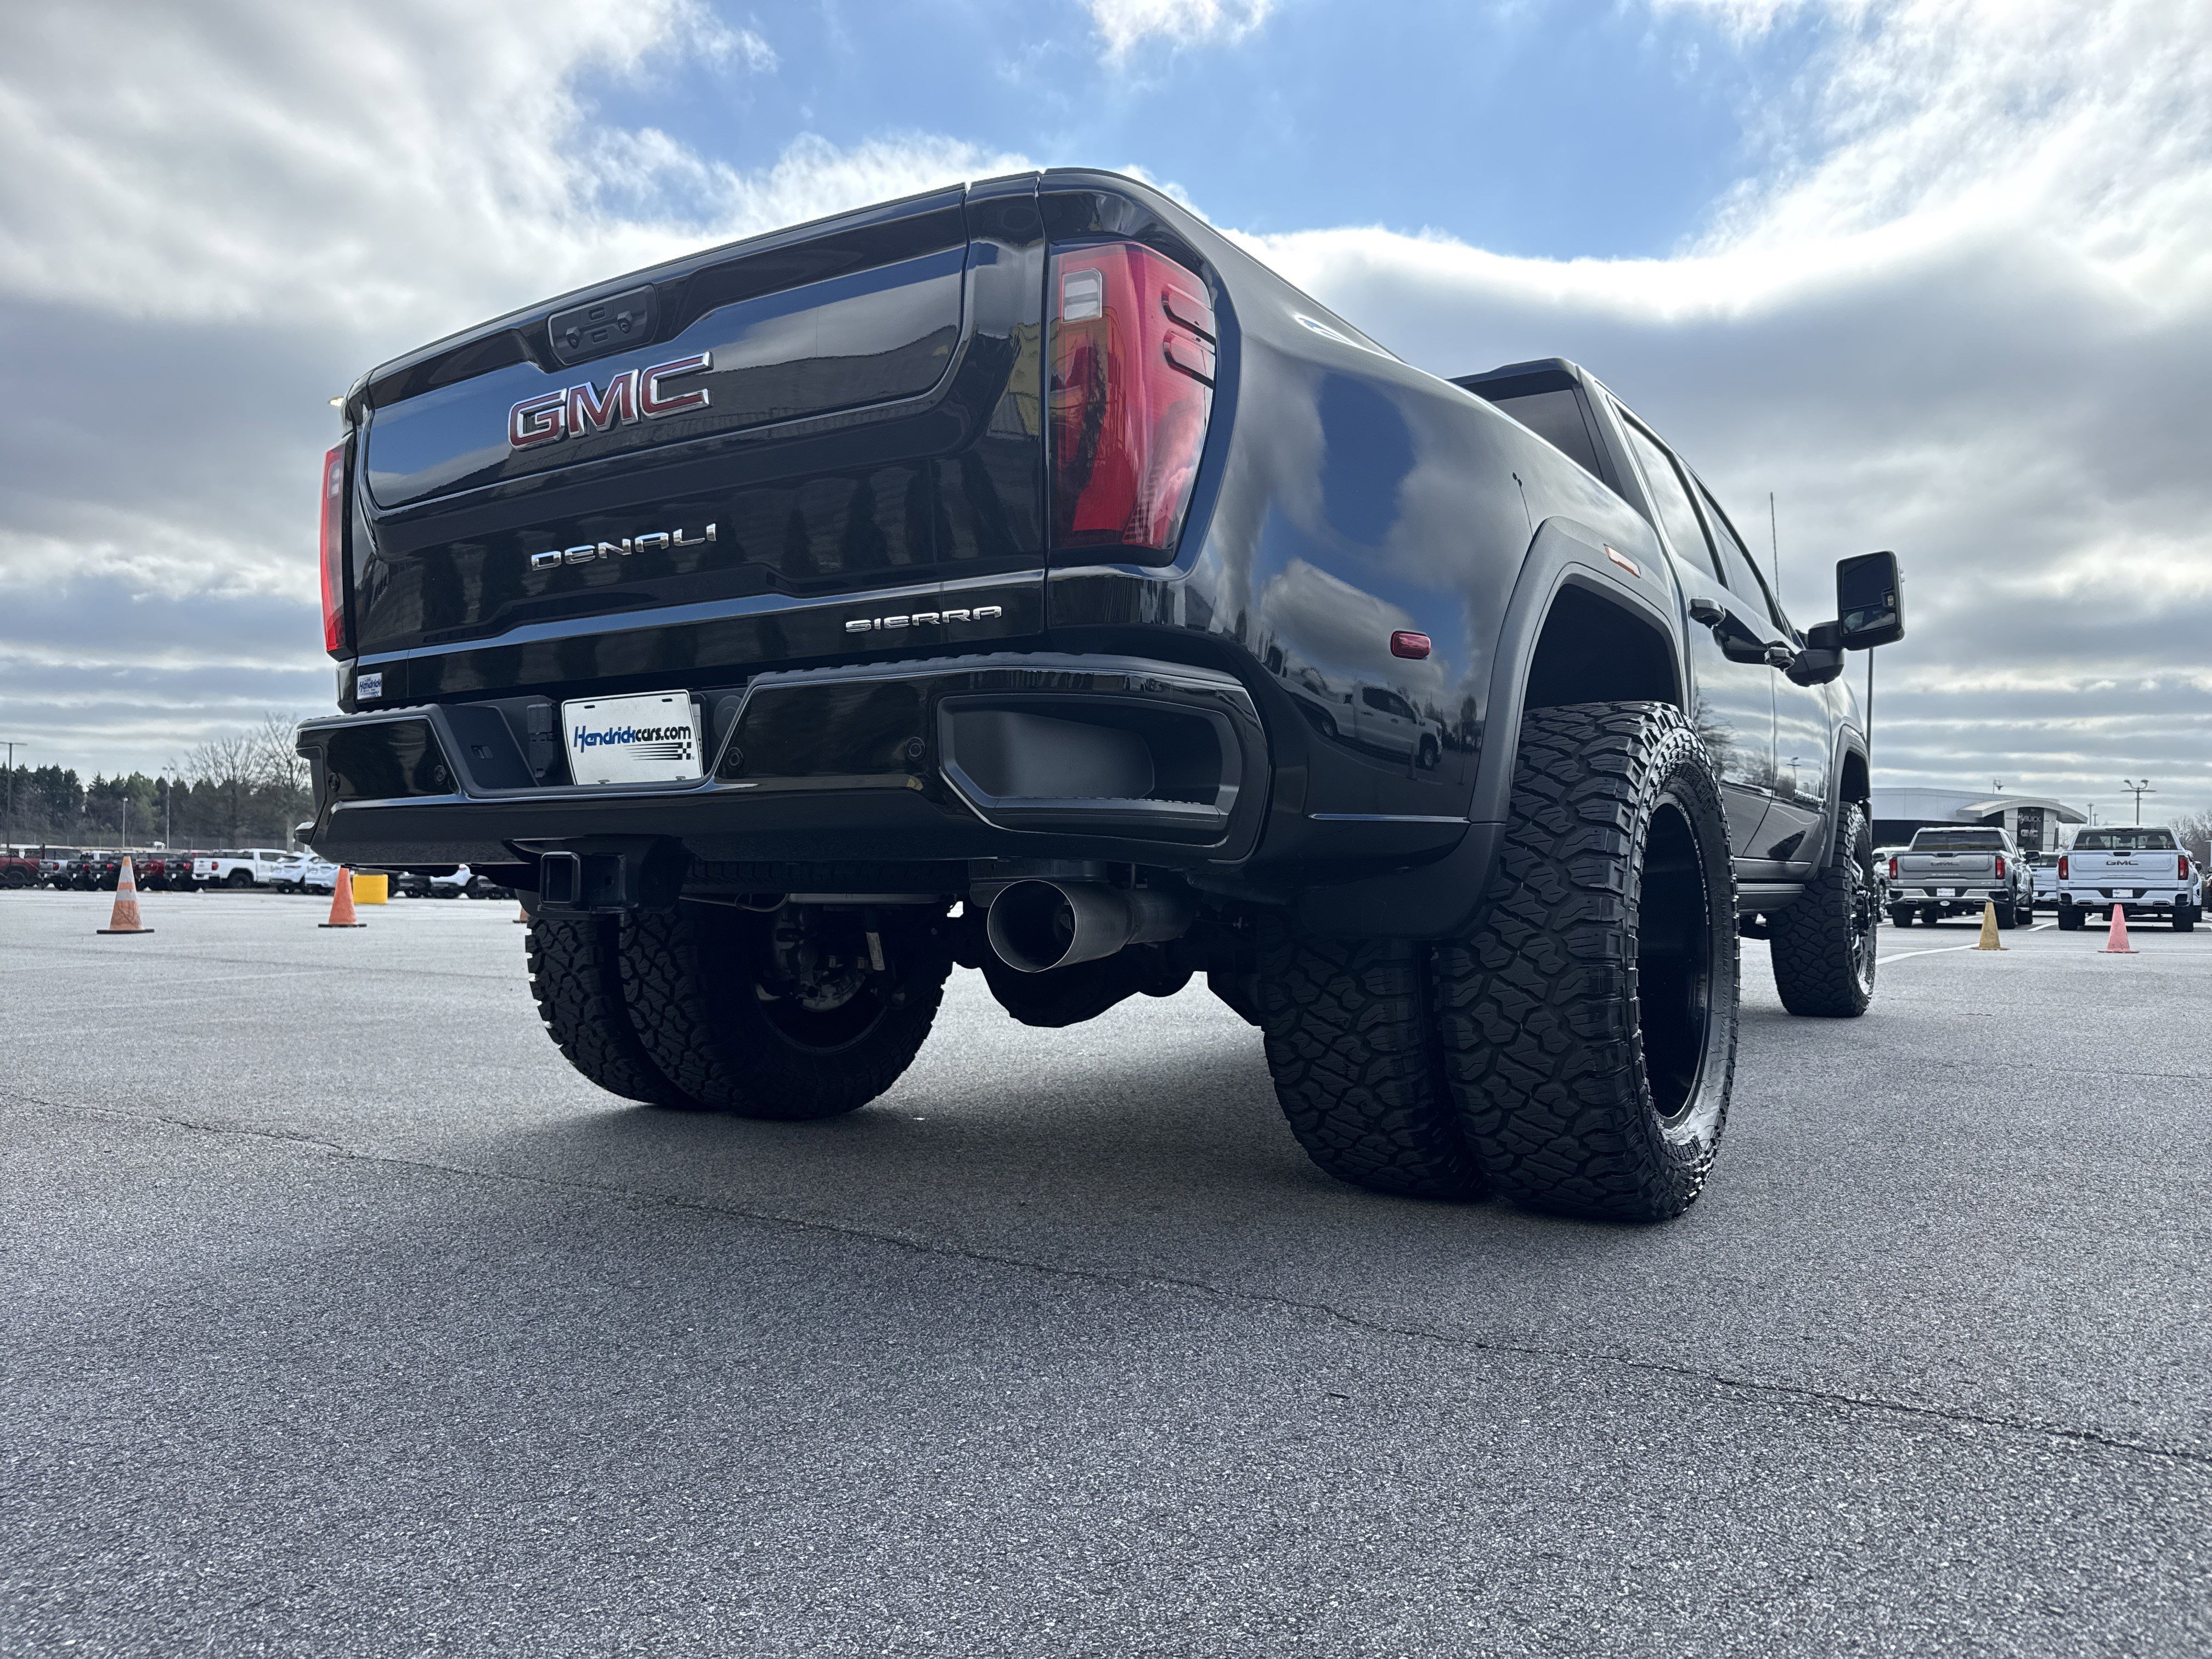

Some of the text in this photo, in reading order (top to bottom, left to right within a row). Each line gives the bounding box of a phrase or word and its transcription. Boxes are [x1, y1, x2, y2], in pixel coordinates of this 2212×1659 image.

[508, 351, 713, 452] GMC
[531, 523, 716, 571] DENALI
[845, 606, 1002, 633] SIERRA
[574, 725, 691, 753] Hendrickcars.com
